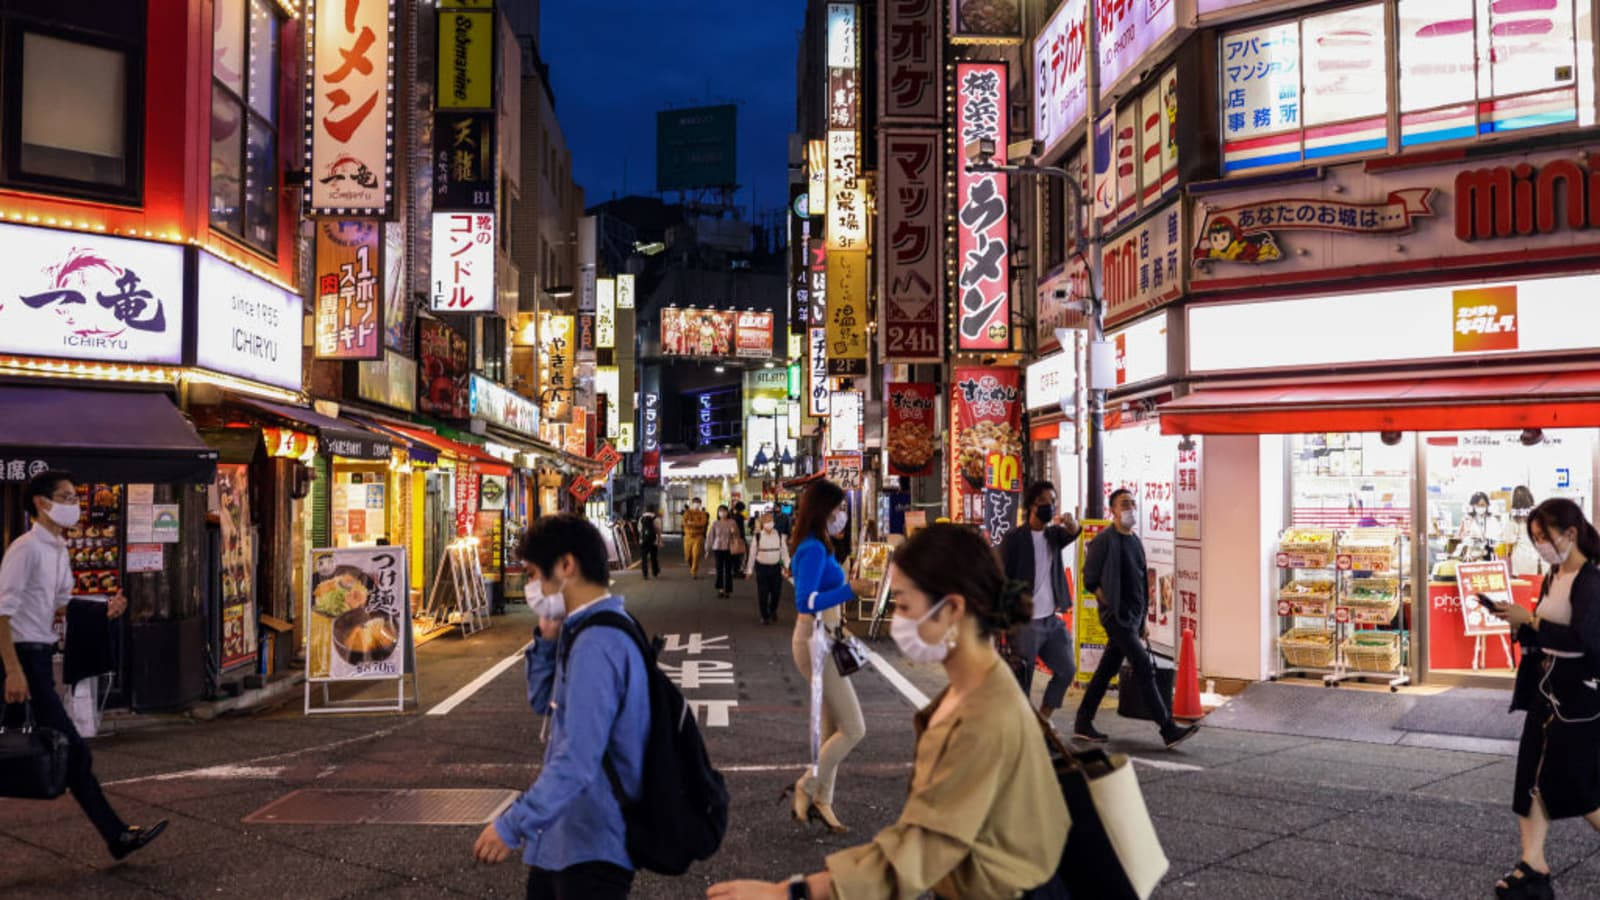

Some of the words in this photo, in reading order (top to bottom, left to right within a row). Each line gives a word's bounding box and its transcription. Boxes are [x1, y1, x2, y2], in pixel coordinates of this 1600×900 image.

[454, 15, 472, 100] Submarine
[1226, 30, 1297, 60] アパート
[1226, 57, 1297, 83] マンション
[1226, 104, 1298, 132] 事務所
[473, 191, 491, 205] B1
[476, 215, 492, 245] 靴の
[838, 236, 857, 248] 3F
[447, 214, 474, 309] コンドル
[18, 267, 167, 333] 一竜
[340, 263, 356, 349] ステーキ
[356, 245, 378, 348] 1ポンド
[433, 280, 445, 309] 1F
[62, 335, 129, 350] ICHIRYU
[231, 327, 278, 362] ICHIRYU
[888, 326, 935, 351] 24h
[812, 339, 828, 413] チカラめし
[836, 359, 857, 372] 2F
[828, 466, 859, 484] チカラ
[988, 454, 1019, 490] 10
[1179, 468, 1197, 491] 写真
